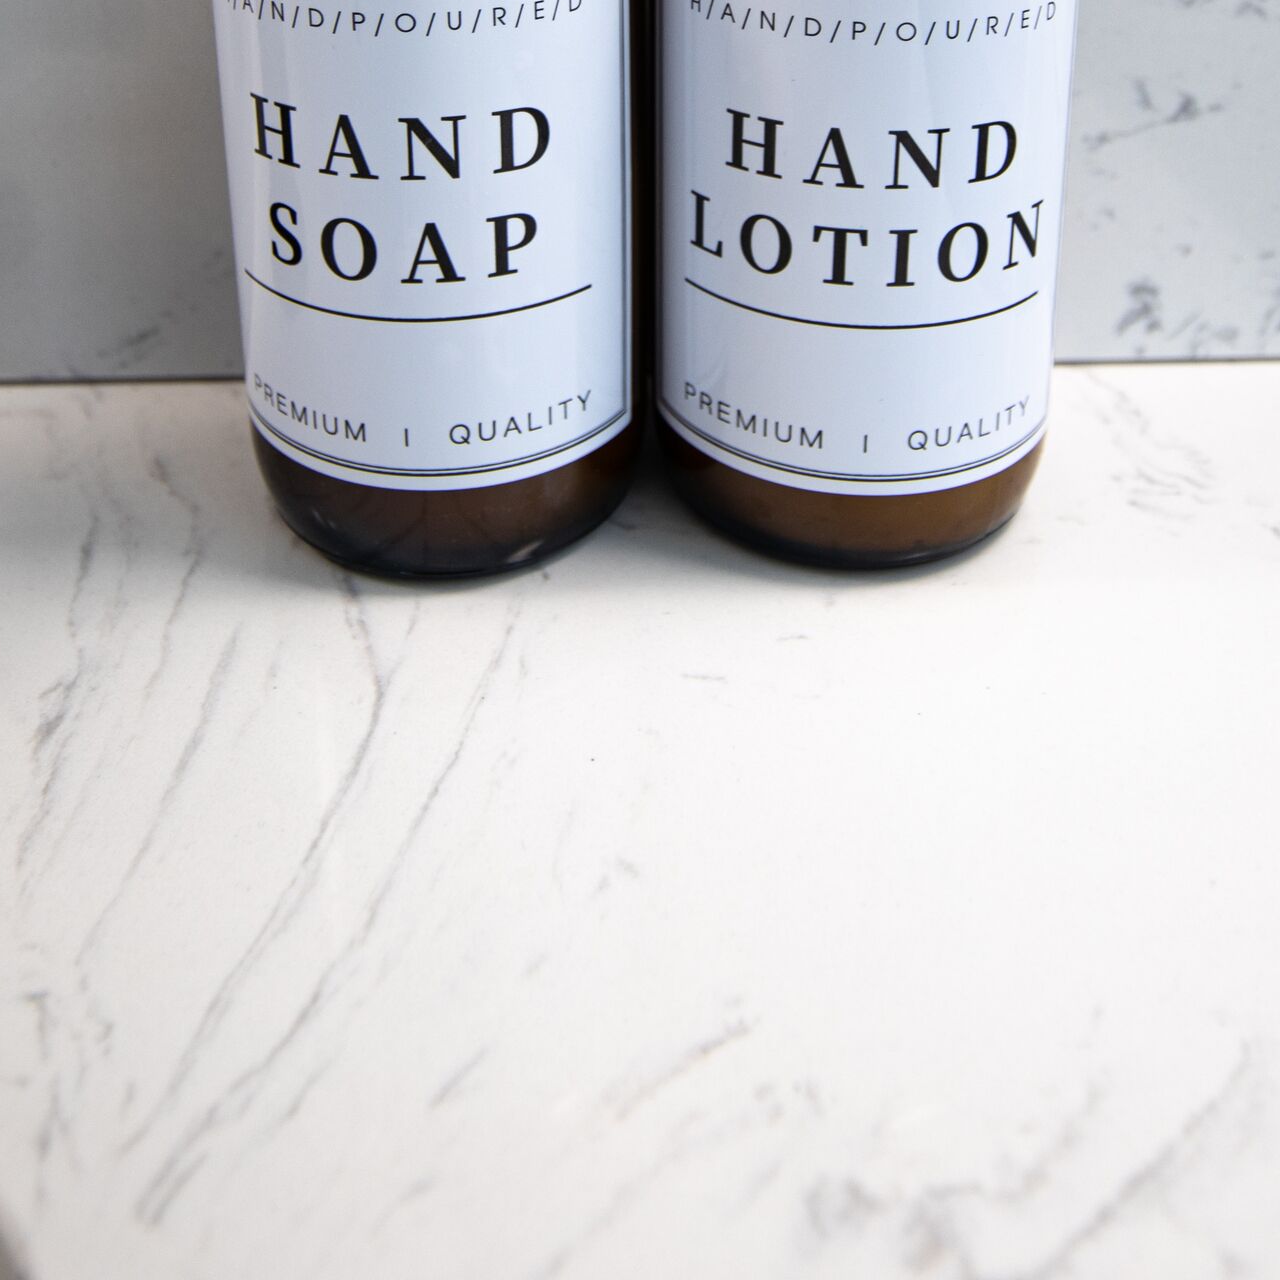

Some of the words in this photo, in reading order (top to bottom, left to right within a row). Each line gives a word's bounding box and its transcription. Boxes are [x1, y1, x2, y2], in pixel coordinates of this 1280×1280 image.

[249, 91, 551, 181] HAND
[724, 107, 1018, 190] HAND
[268, 201, 538, 284] SOAP
[689, 189, 1045, 288] LOTION
[252, 373, 368, 443] PREMIUM
[448, 389, 593, 446] QUALITY
[684, 381, 824, 450] PREMIUM
[906, 395, 1032, 451] QUALITY
